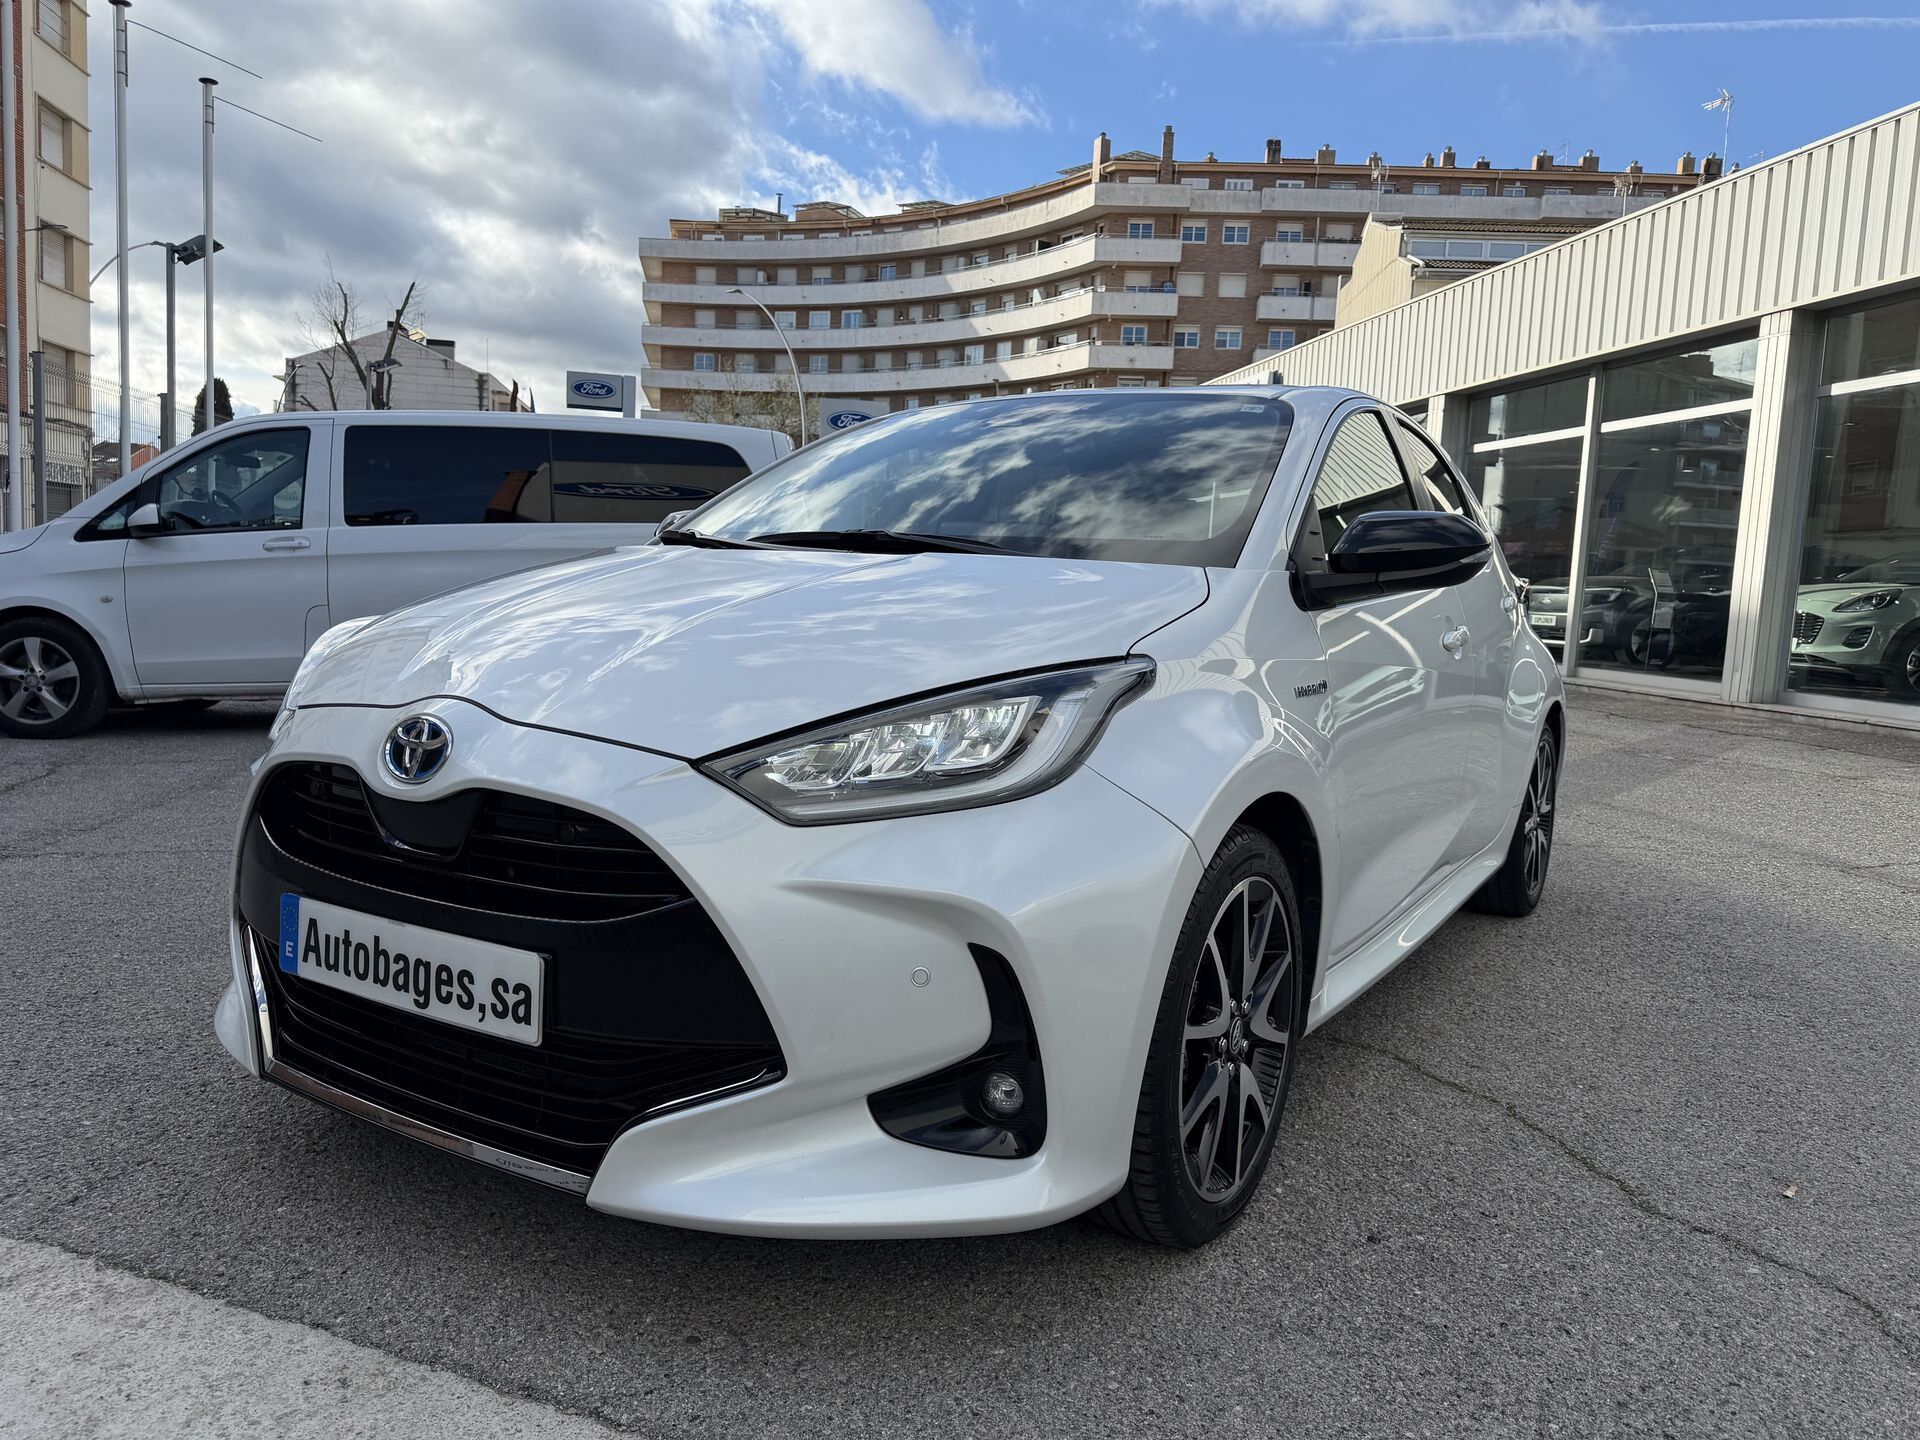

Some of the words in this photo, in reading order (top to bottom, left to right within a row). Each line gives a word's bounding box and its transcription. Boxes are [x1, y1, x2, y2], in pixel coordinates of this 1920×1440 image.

[580, 383, 608, 395] Ford
[837, 414, 862, 427] Fo
[285, 940, 294, 958] E
[301, 917, 533, 1026] Autobages,sa
